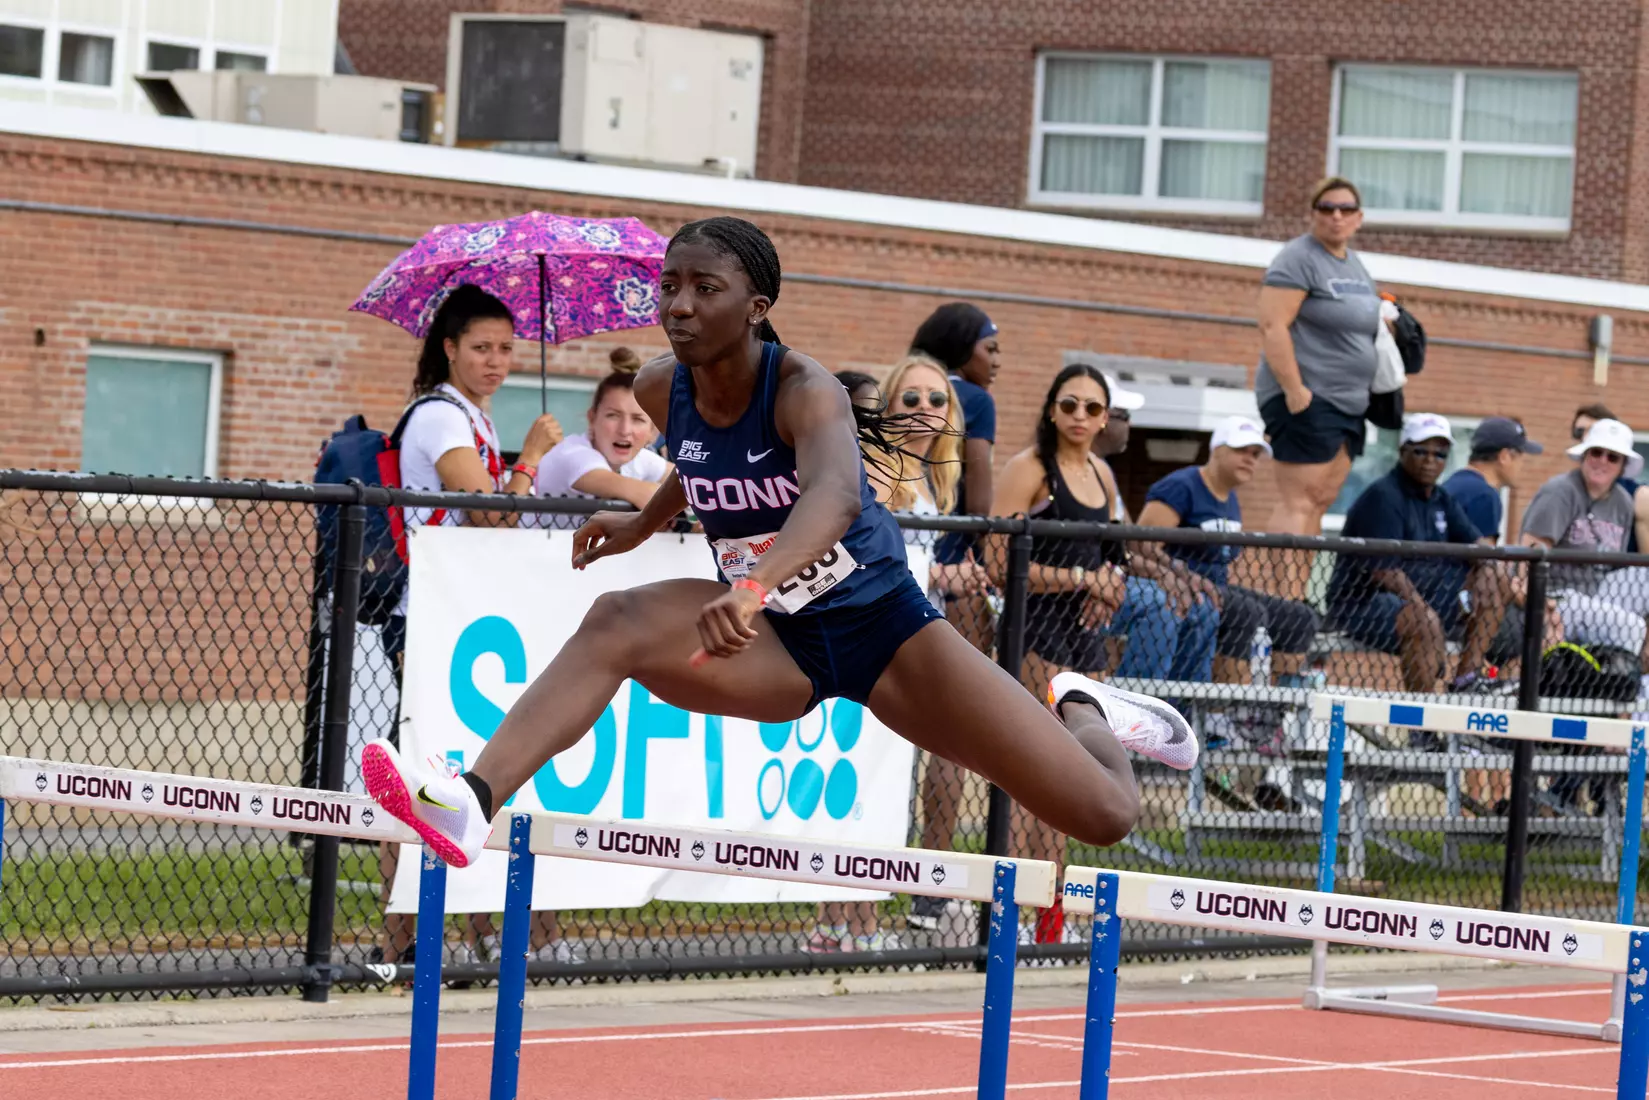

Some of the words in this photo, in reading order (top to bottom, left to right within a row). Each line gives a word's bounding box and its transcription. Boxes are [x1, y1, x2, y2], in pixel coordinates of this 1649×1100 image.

[681, 440, 703, 451] BIG
[678, 449, 711, 461] EAST
[721, 552, 738, 561] BIG
[722, 557, 745, 566] EAST
[57, 774, 132, 800] UCONN
[163, 785, 240, 813] UCONN
[272, 797, 351, 825] UCONN
[598, 829, 680, 858] UCONN
[715, 842, 799, 871] UCONN
[834, 854, 920, 883] UCONN
[1195, 891, 1287, 923] UCONN
[1324, 906, 1417, 938] UCONN
[1456, 921, 1550, 952] UCONN
